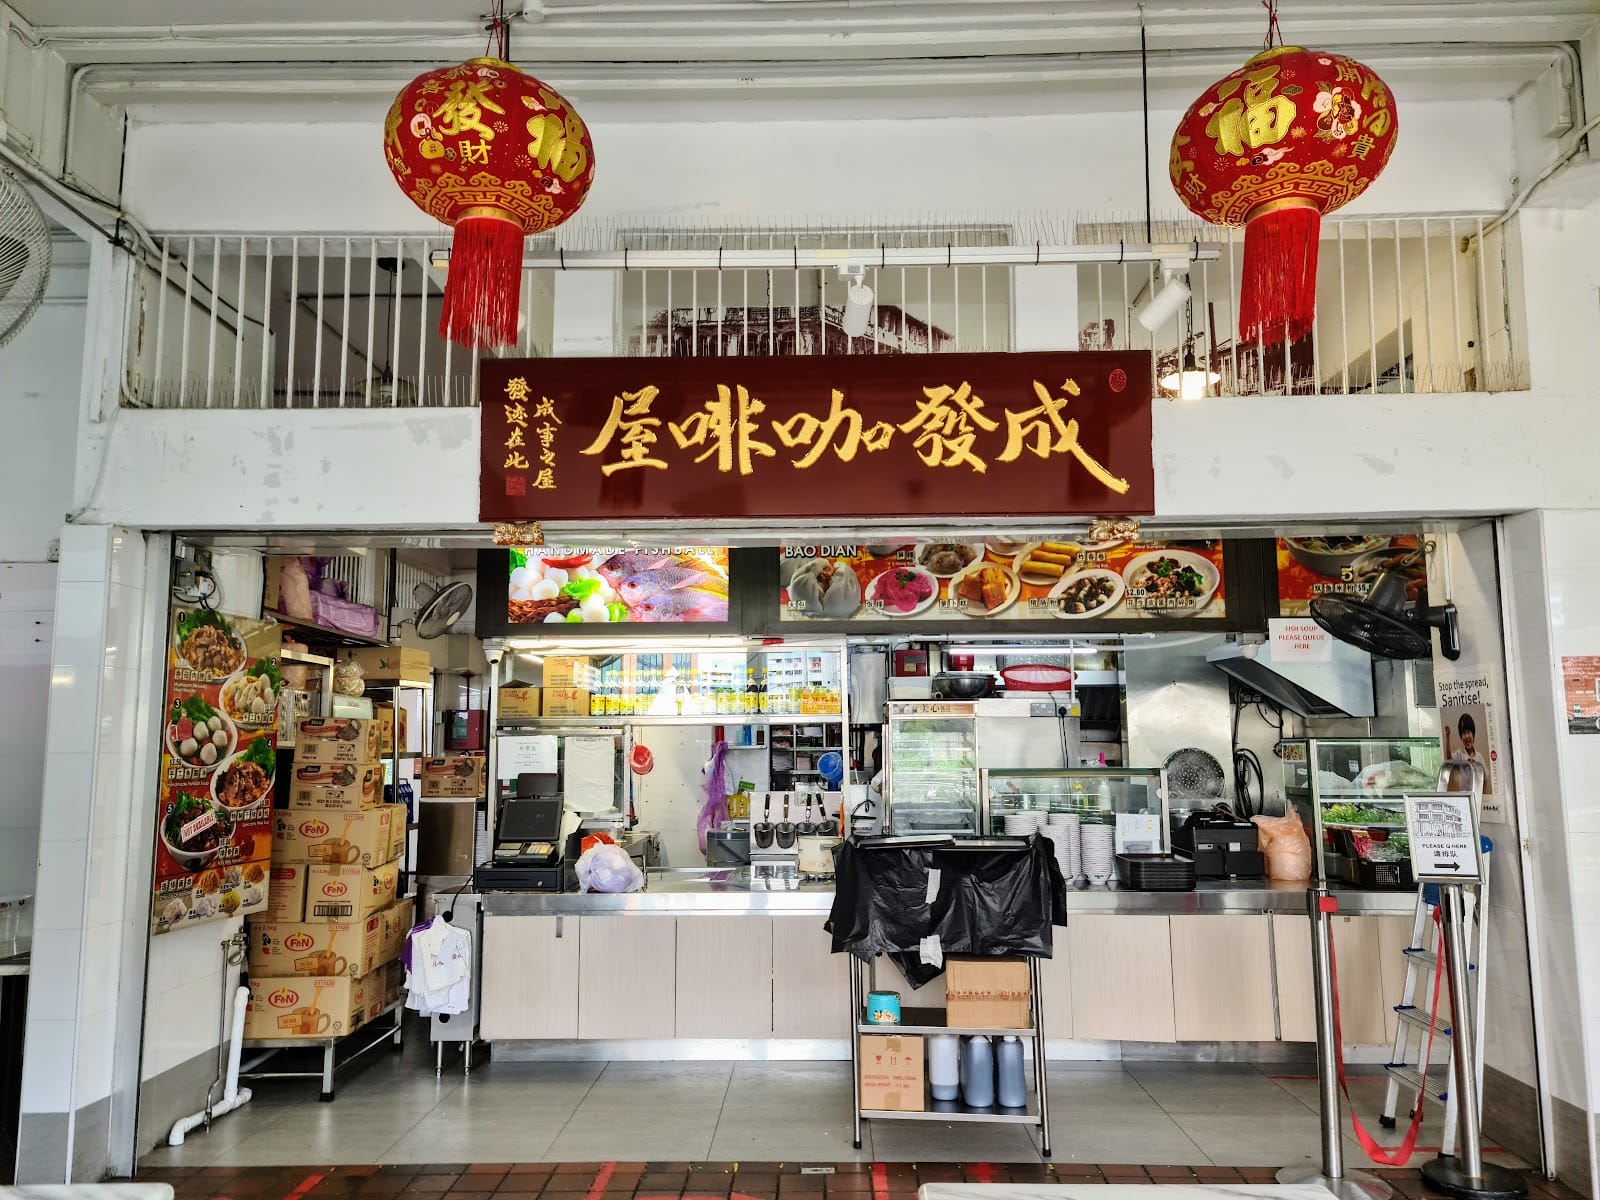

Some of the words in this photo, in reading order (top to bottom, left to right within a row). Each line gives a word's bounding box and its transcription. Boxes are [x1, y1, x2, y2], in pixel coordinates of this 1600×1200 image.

[785, 545, 817, 557] BAO
[820, 545, 858, 557] DIAN
[1341, 566, 1353, 582] 5
[1439, 681, 1453, 693] Stop
[1454, 679, 1464, 690] the
[1465, 675, 1489, 691] spread,
[1442, 689, 1481, 707] Sanitise!
